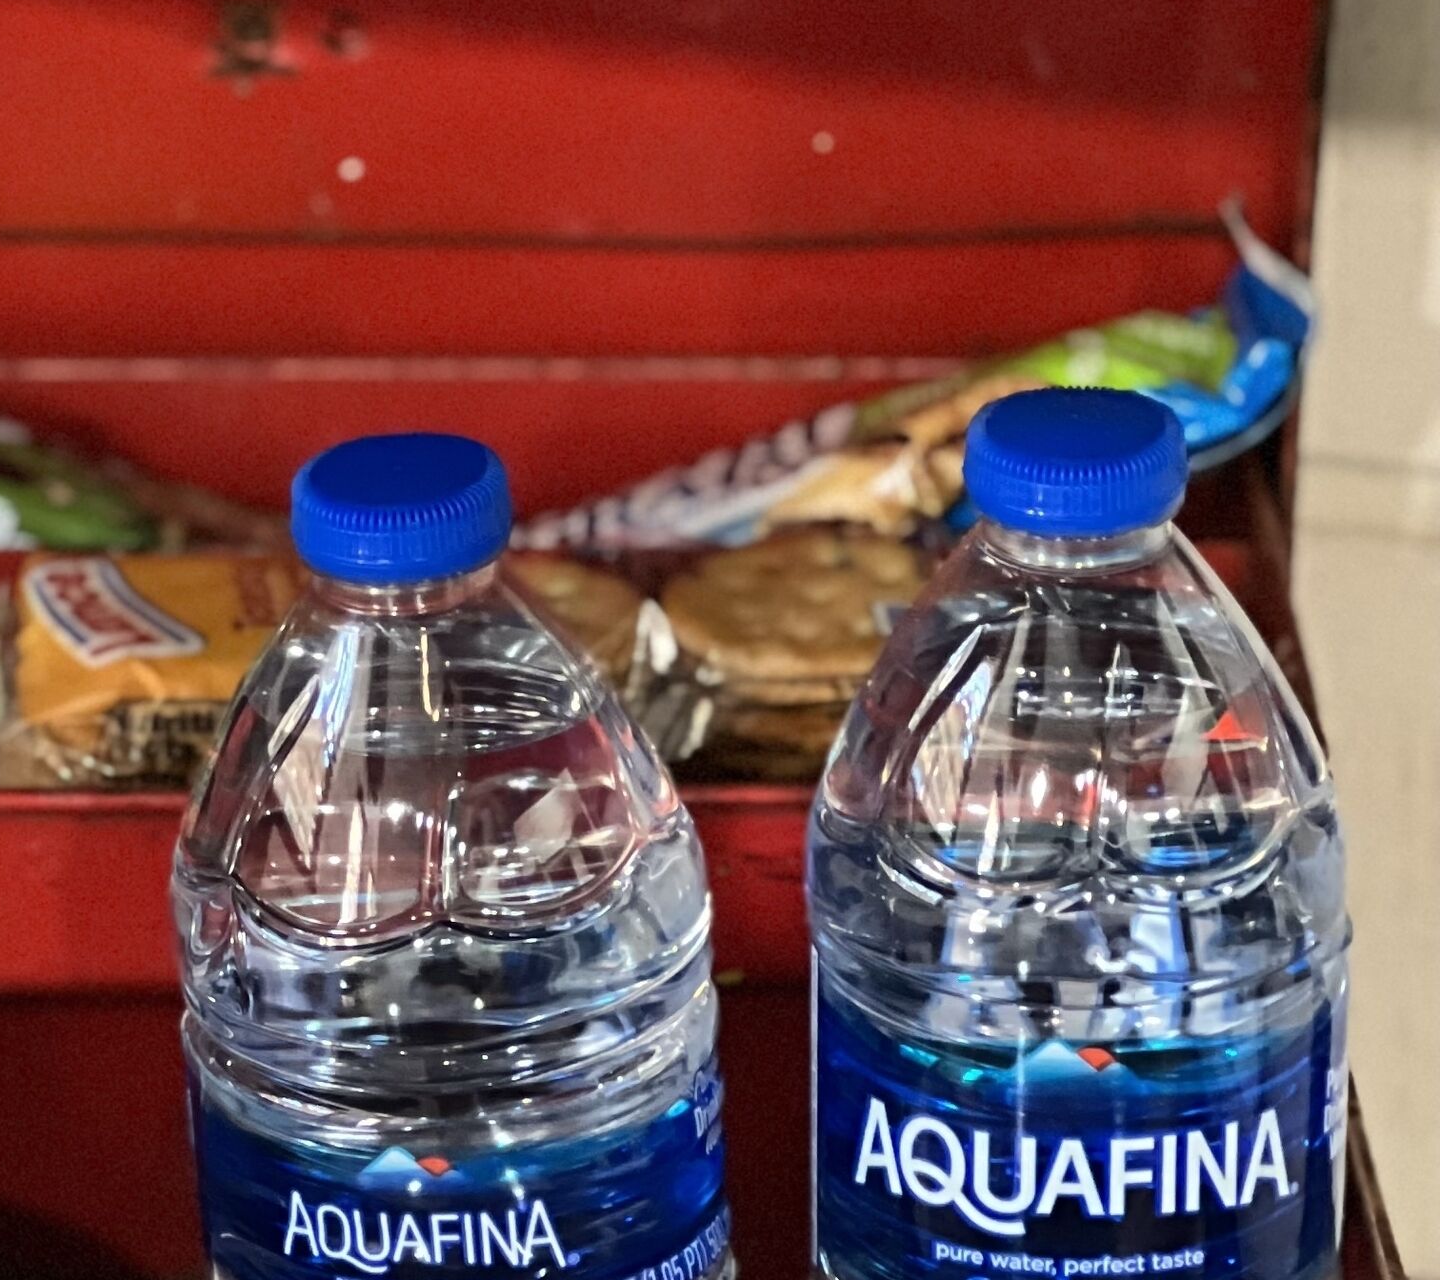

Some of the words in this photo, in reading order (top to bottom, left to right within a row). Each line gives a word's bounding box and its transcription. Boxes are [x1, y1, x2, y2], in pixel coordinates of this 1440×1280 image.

[854, 1095, 1293, 1236] AQUAFINA
[283, 1190, 567, 1274] AQUAFINA
[683, 1240, 709, 1280] PT)
[935, 1241, 984, 1265] pure
[990, 1252, 1057, 1276] water,
[1064, 1253, 1145, 1277] perfect
[1151, 1249, 1205, 1270] taste
